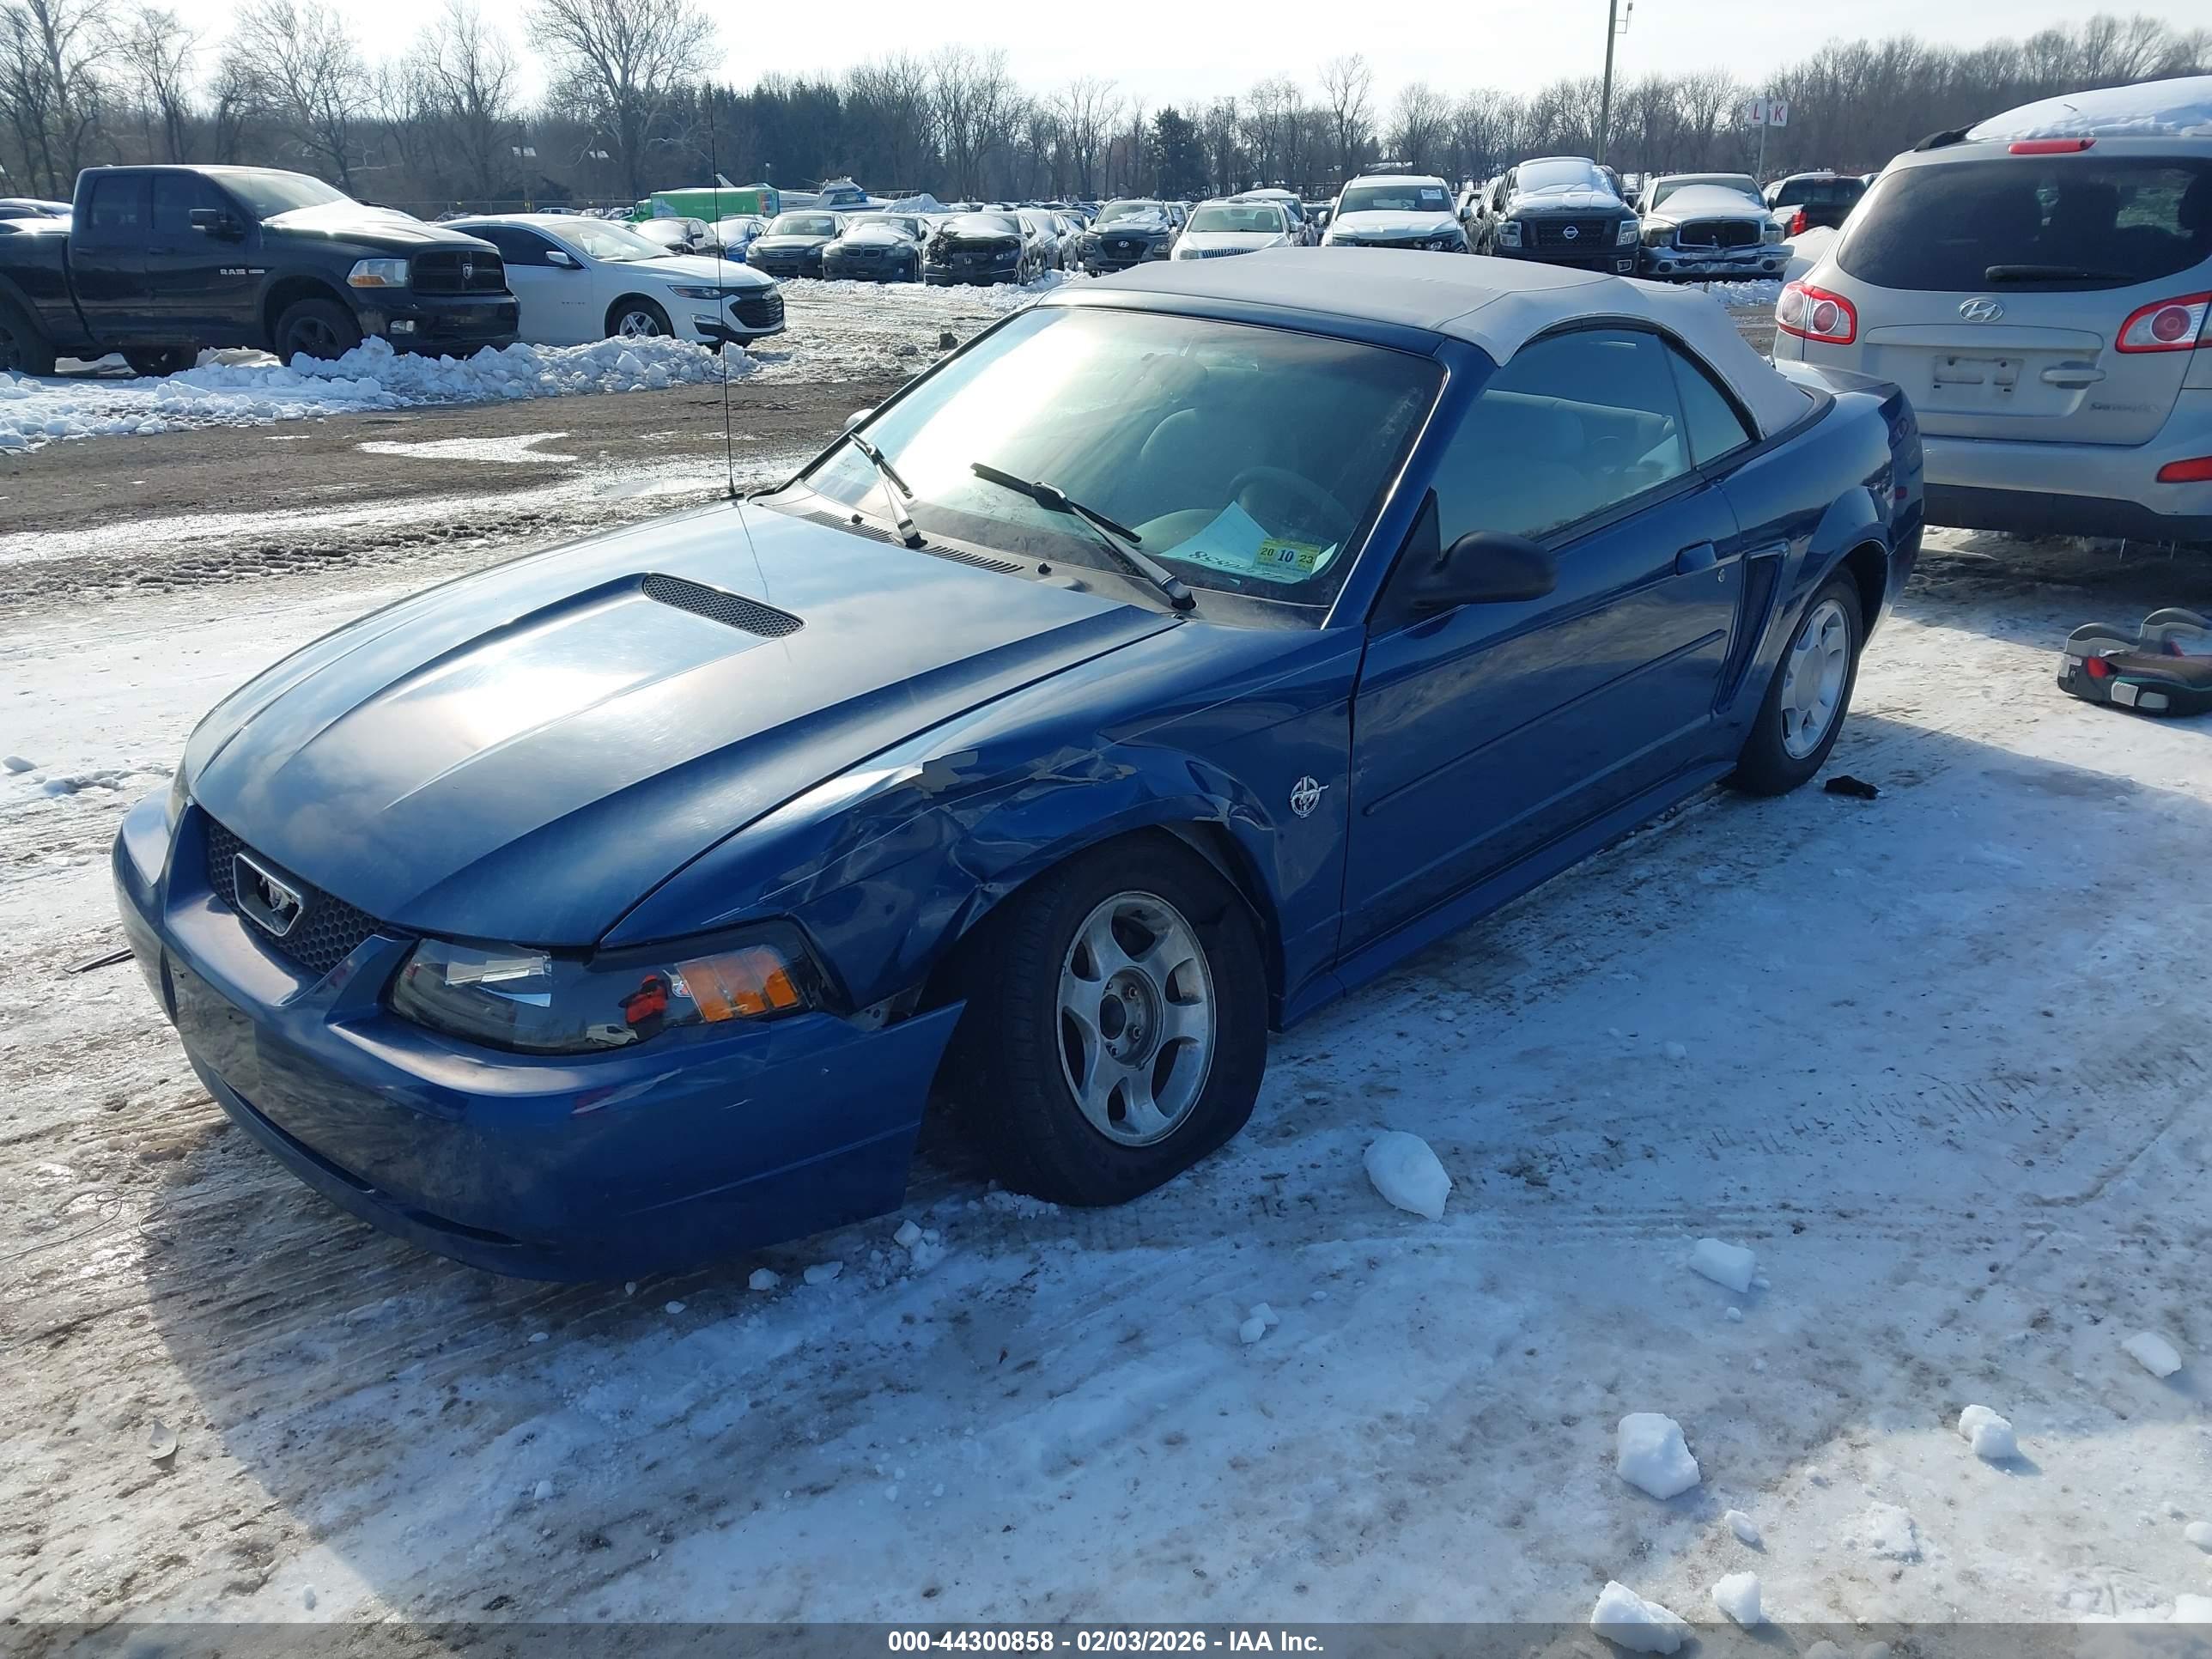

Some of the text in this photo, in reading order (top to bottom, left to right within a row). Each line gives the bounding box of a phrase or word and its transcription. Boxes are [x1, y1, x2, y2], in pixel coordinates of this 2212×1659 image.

[1753, 103, 1760, 120] L
[1774, 105, 1784, 122] K
[1260, 547, 1314, 564] 20 10 23
